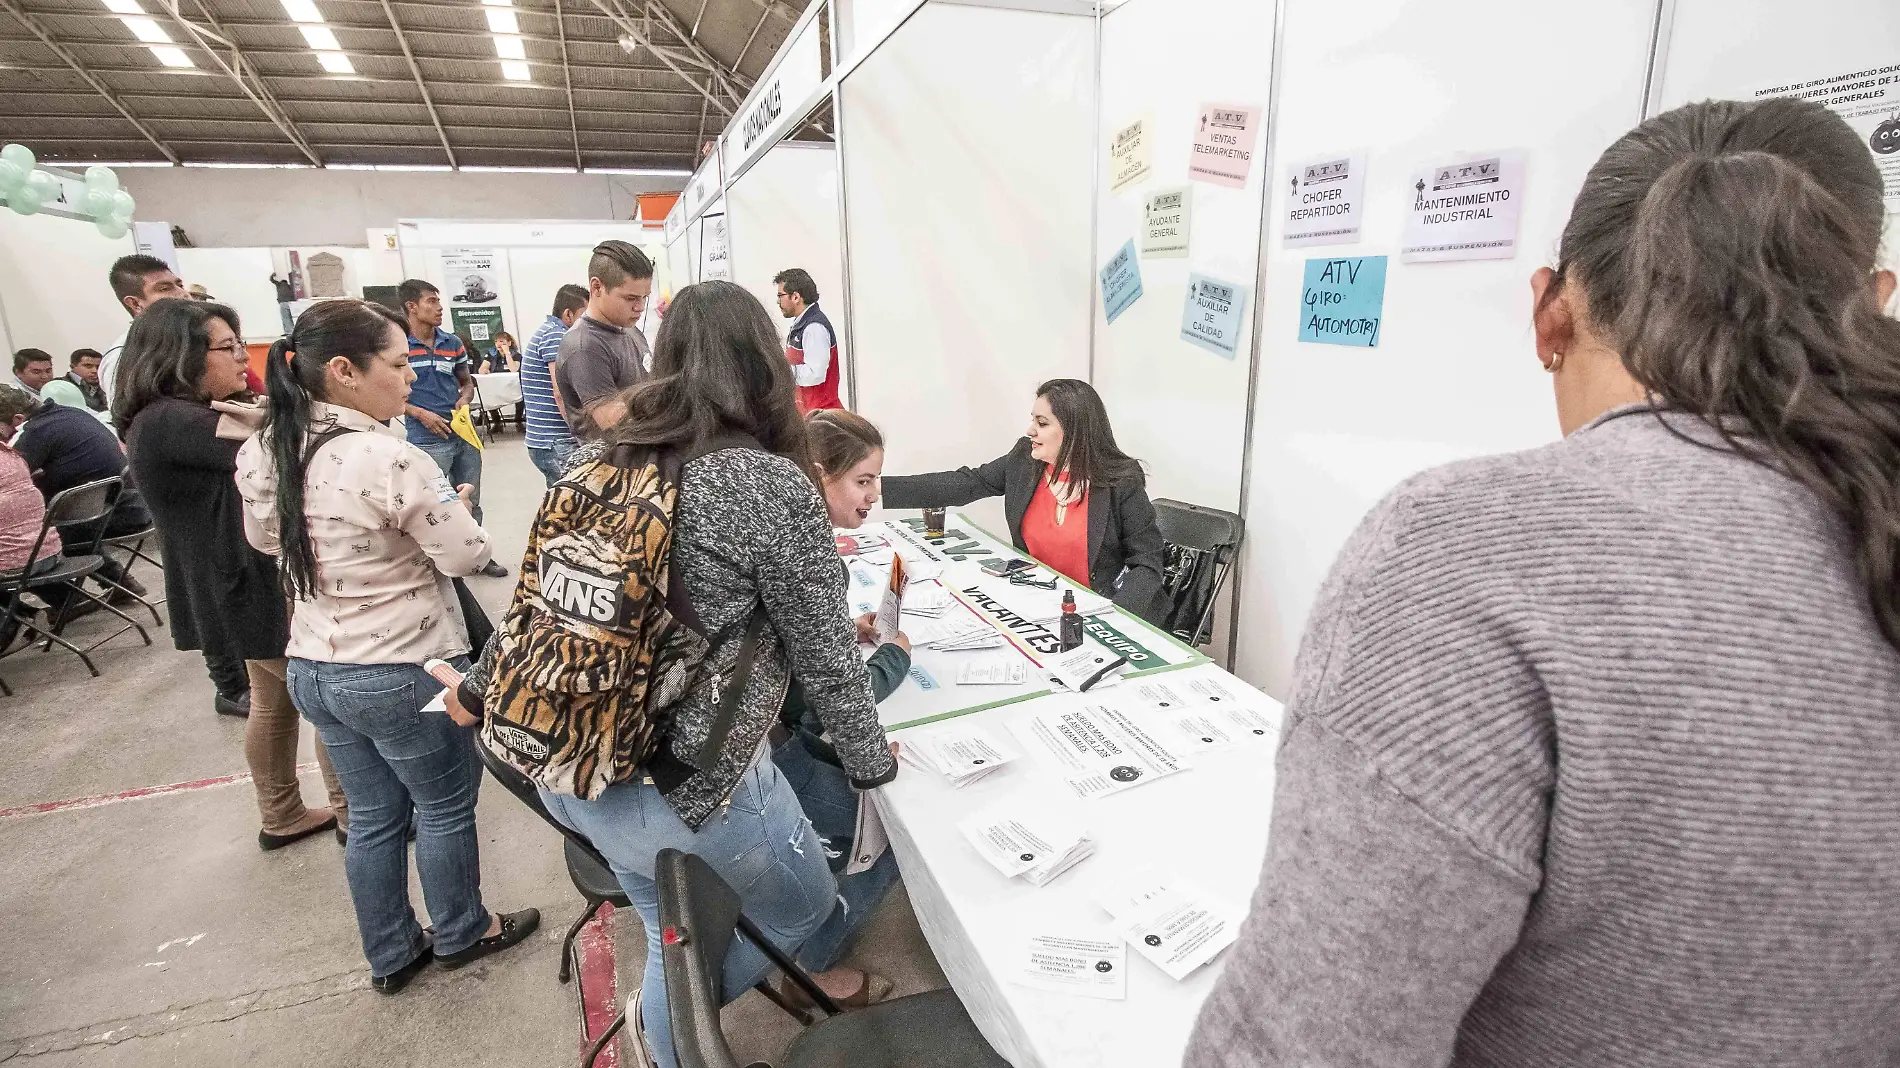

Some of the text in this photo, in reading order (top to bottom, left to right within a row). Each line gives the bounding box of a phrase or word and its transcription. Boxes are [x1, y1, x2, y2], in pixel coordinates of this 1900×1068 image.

[1755, 86, 1789, 97] EMPRESA
[1791, 83, 1804, 91] DEL
[1806, 79, 1825, 88] GIRO
[1826, 69, 1877, 84] ALIMENTICIO
[1831, 79, 1876, 94] MAYORES
[1878, 76, 1891, 85] DE
[1831, 89, 1885, 105] GENERALES
[1116, 138, 1141, 158] AUXILIAR
[1210, 134, 1237, 145] VENTAS
[1125, 154, 1133, 164] DE
[1193, 143, 1250, 161] TELEMARKETING
[1306, 163, 1346, 178] A.T.V.
[1439, 164, 1495, 181] A.T.V.
[1302, 188, 1342, 204] CHOFER
[1414, 189, 1510, 211] MANTENIMIENTO
[1149, 214, 1181, 227] AYUDANTE
[1290, 203, 1351, 221] REPARTIDOR
[1423, 208, 1493, 224] INDUSTRIAL
[1149, 228, 1178, 239] GENERAL
[1320, 259, 1363, 285] ATV
[1197, 298, 1229, 315] AUXILIAR
[1204, 312, 1215, 324] DE
[1192, 321, 1223, 339] CALIDAD
[1307, 314, 1379, 347] AUTOMOTRIZ
[539, 552, 620, 622] VANS
[961, 585, 1061, 654] VACANTES
[1085, 622, 1149, 661] EQUIPO
[512, 737, 525, 750] THE
